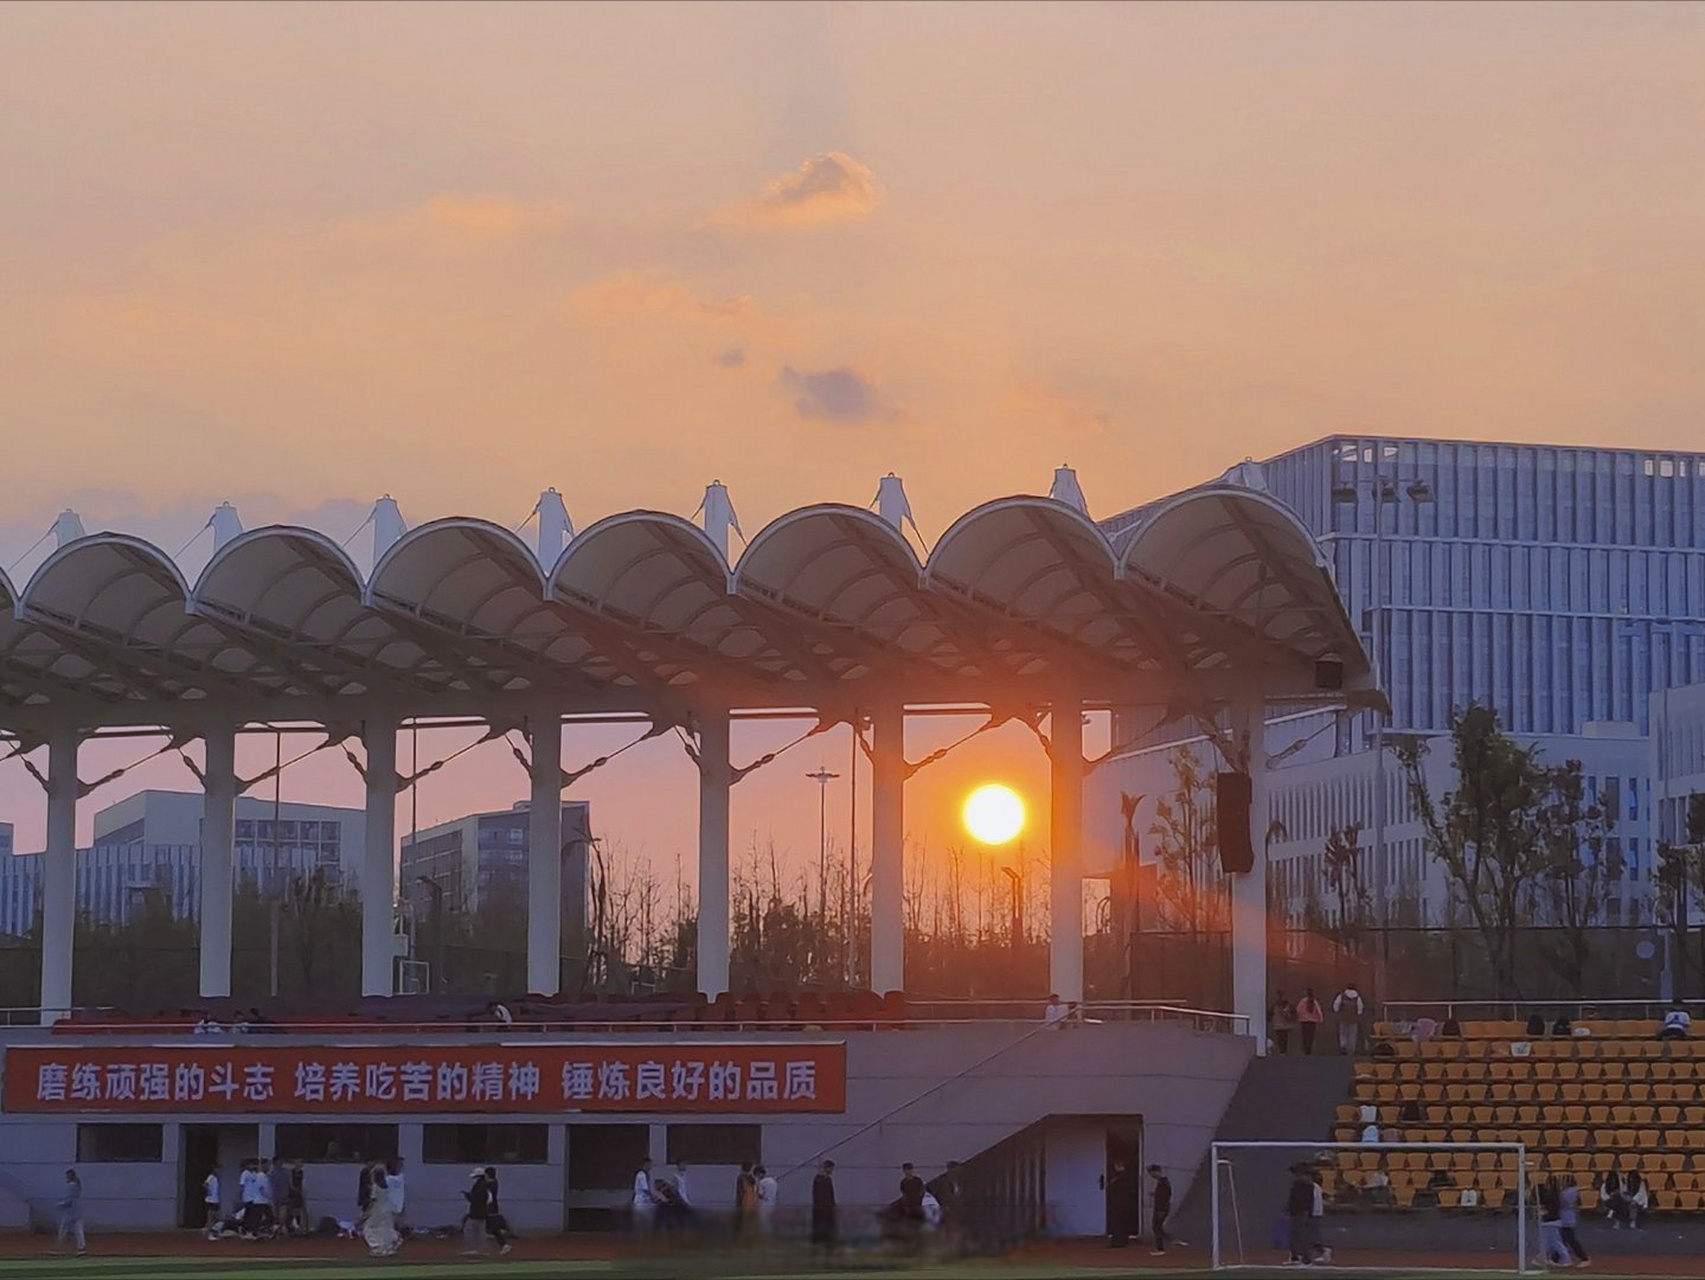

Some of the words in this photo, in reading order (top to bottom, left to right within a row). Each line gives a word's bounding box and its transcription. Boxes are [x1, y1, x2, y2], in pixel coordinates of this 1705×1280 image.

[37, 1063, 274, 1100] 磨练顽强的斗志
[294, 1062, 540, 1100] 培养吃苦的精神
[561, 1060, 816, 1100] 锤炼良好的品质
